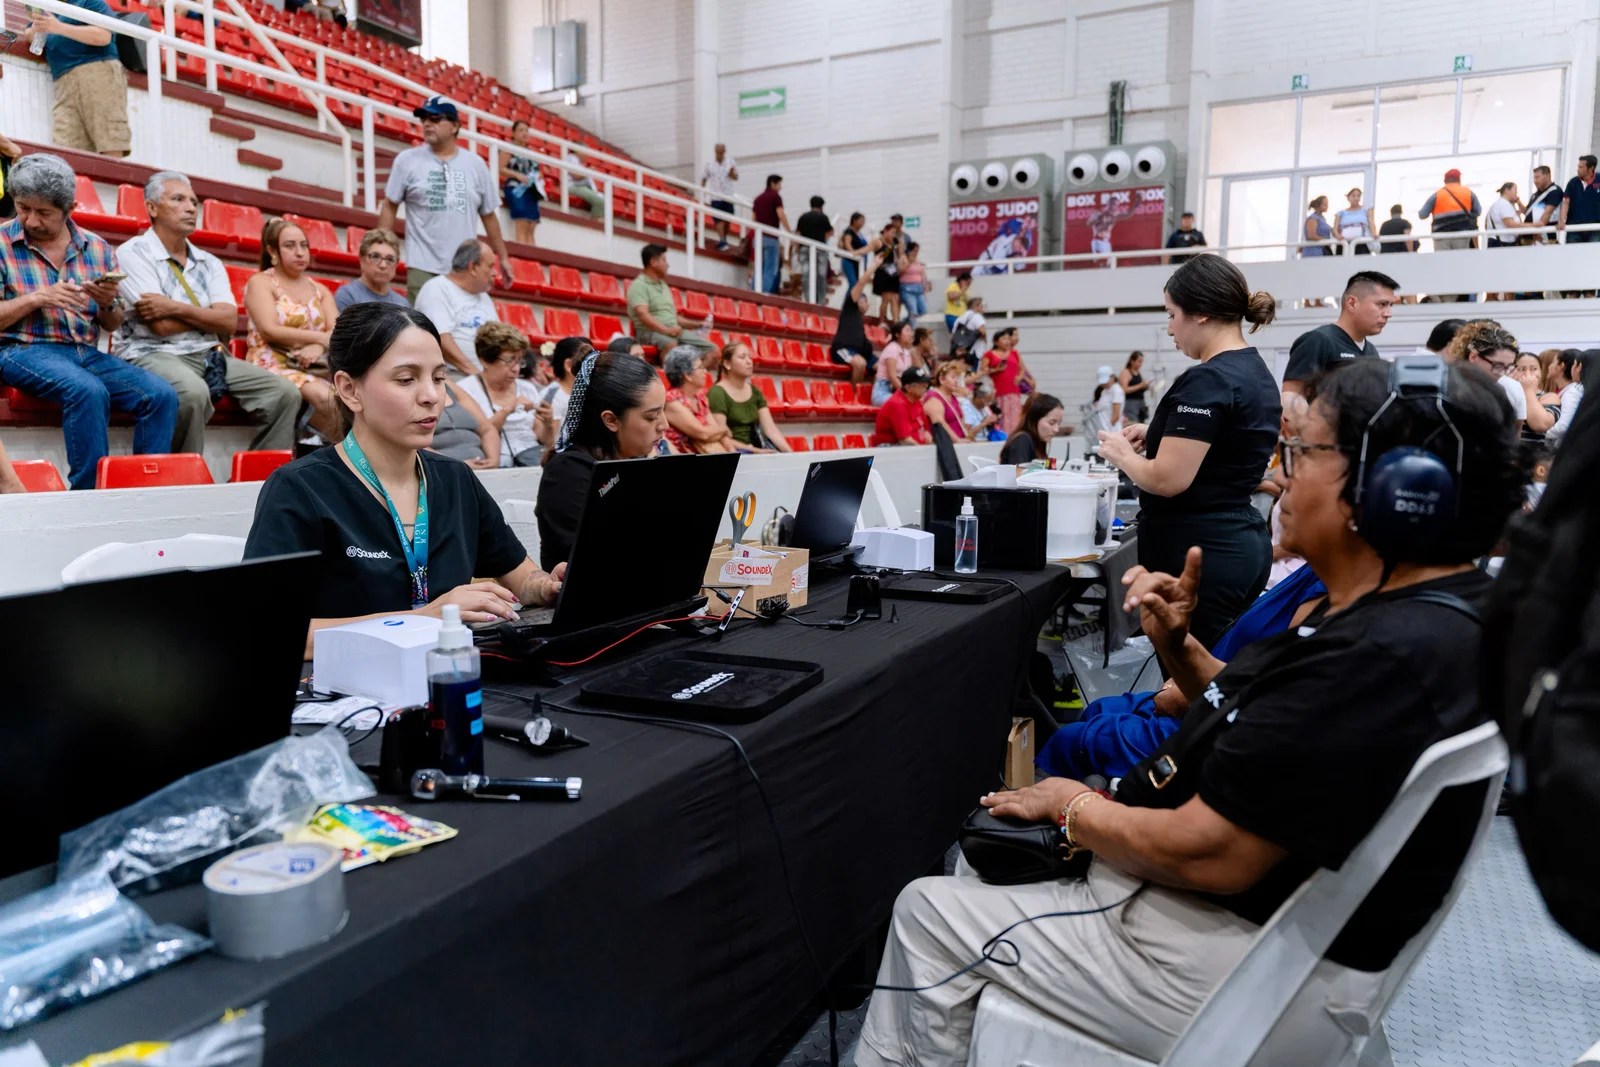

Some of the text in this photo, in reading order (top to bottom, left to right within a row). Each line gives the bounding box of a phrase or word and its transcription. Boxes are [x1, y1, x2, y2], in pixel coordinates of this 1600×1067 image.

[1067, 194, 1096, 208] BOX
[949, 201, 1039, 221] JUDO JUDO
[950, 221, 989, 236] JUDO
